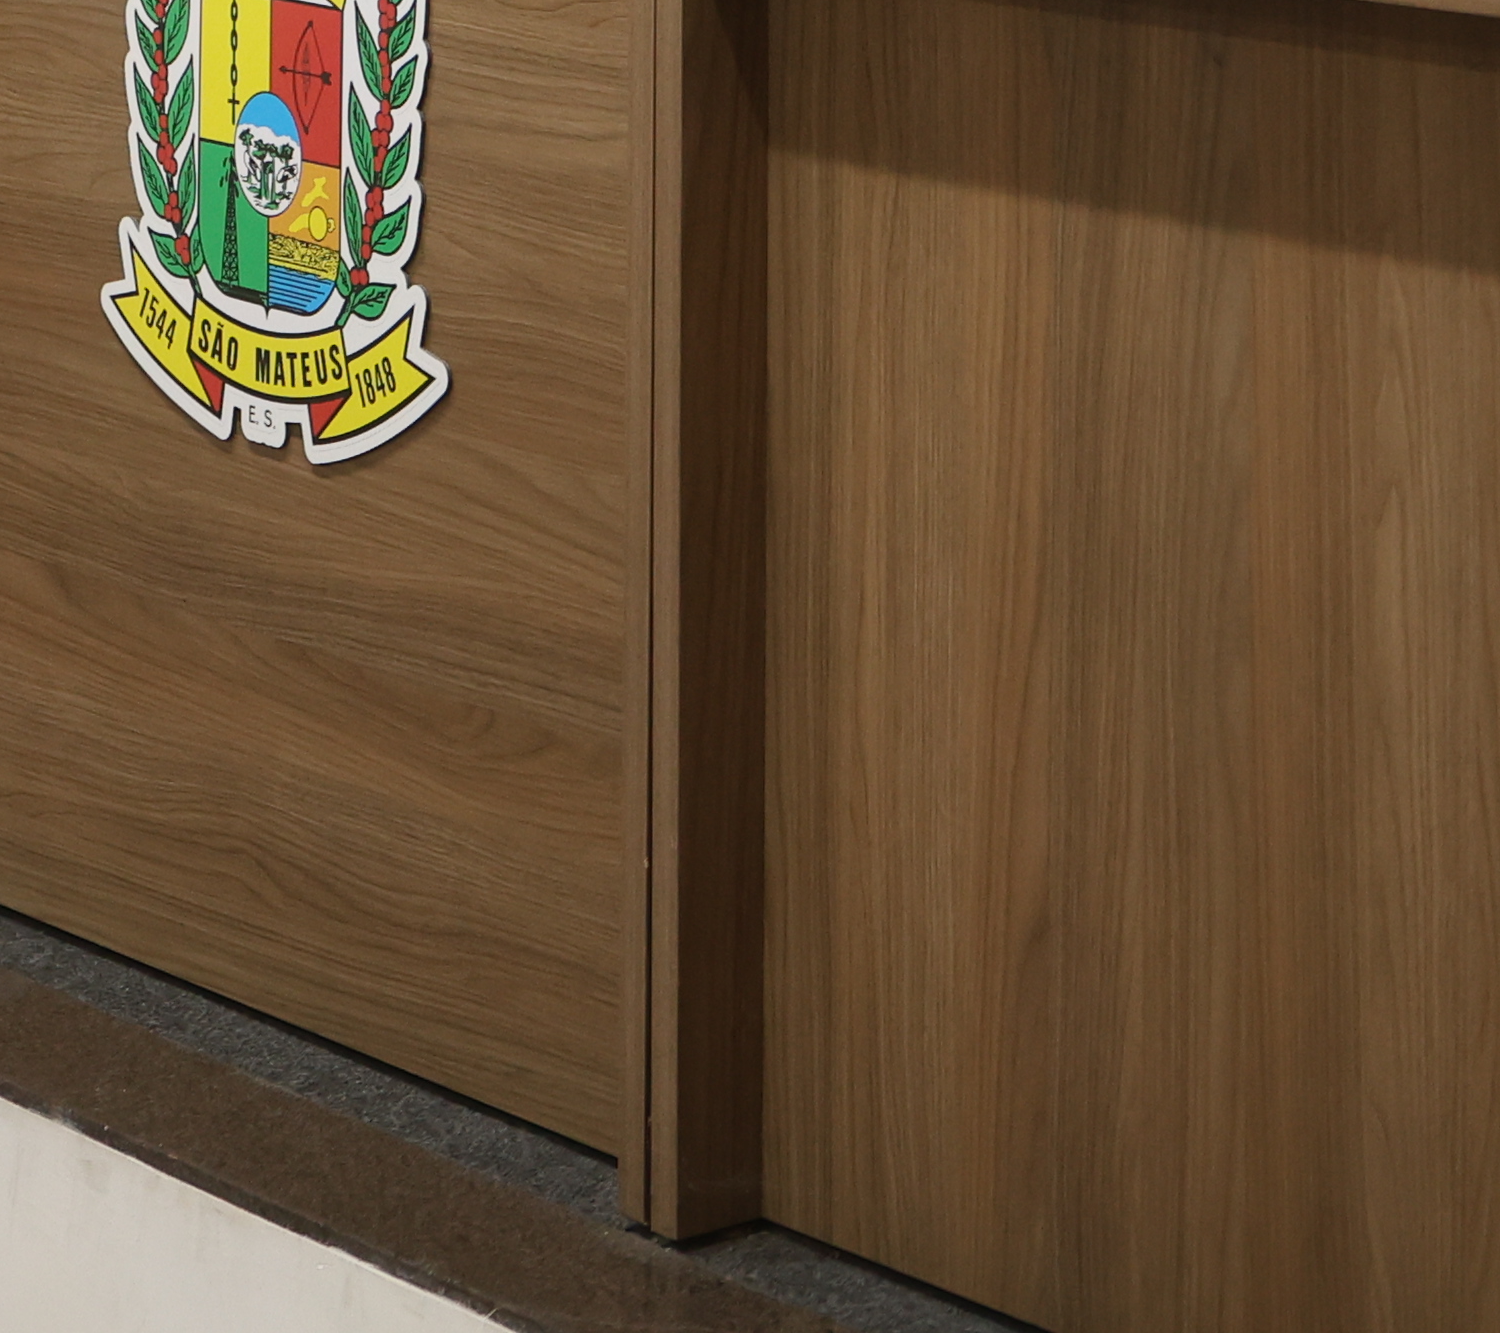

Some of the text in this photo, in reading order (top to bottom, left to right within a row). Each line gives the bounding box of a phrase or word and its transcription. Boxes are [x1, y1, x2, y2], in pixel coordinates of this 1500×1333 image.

[139, 287, 177, 350] 1544
[198, 318, 343, 388] SÃO MATEUS
[355, 356, 397, 408] 1848
